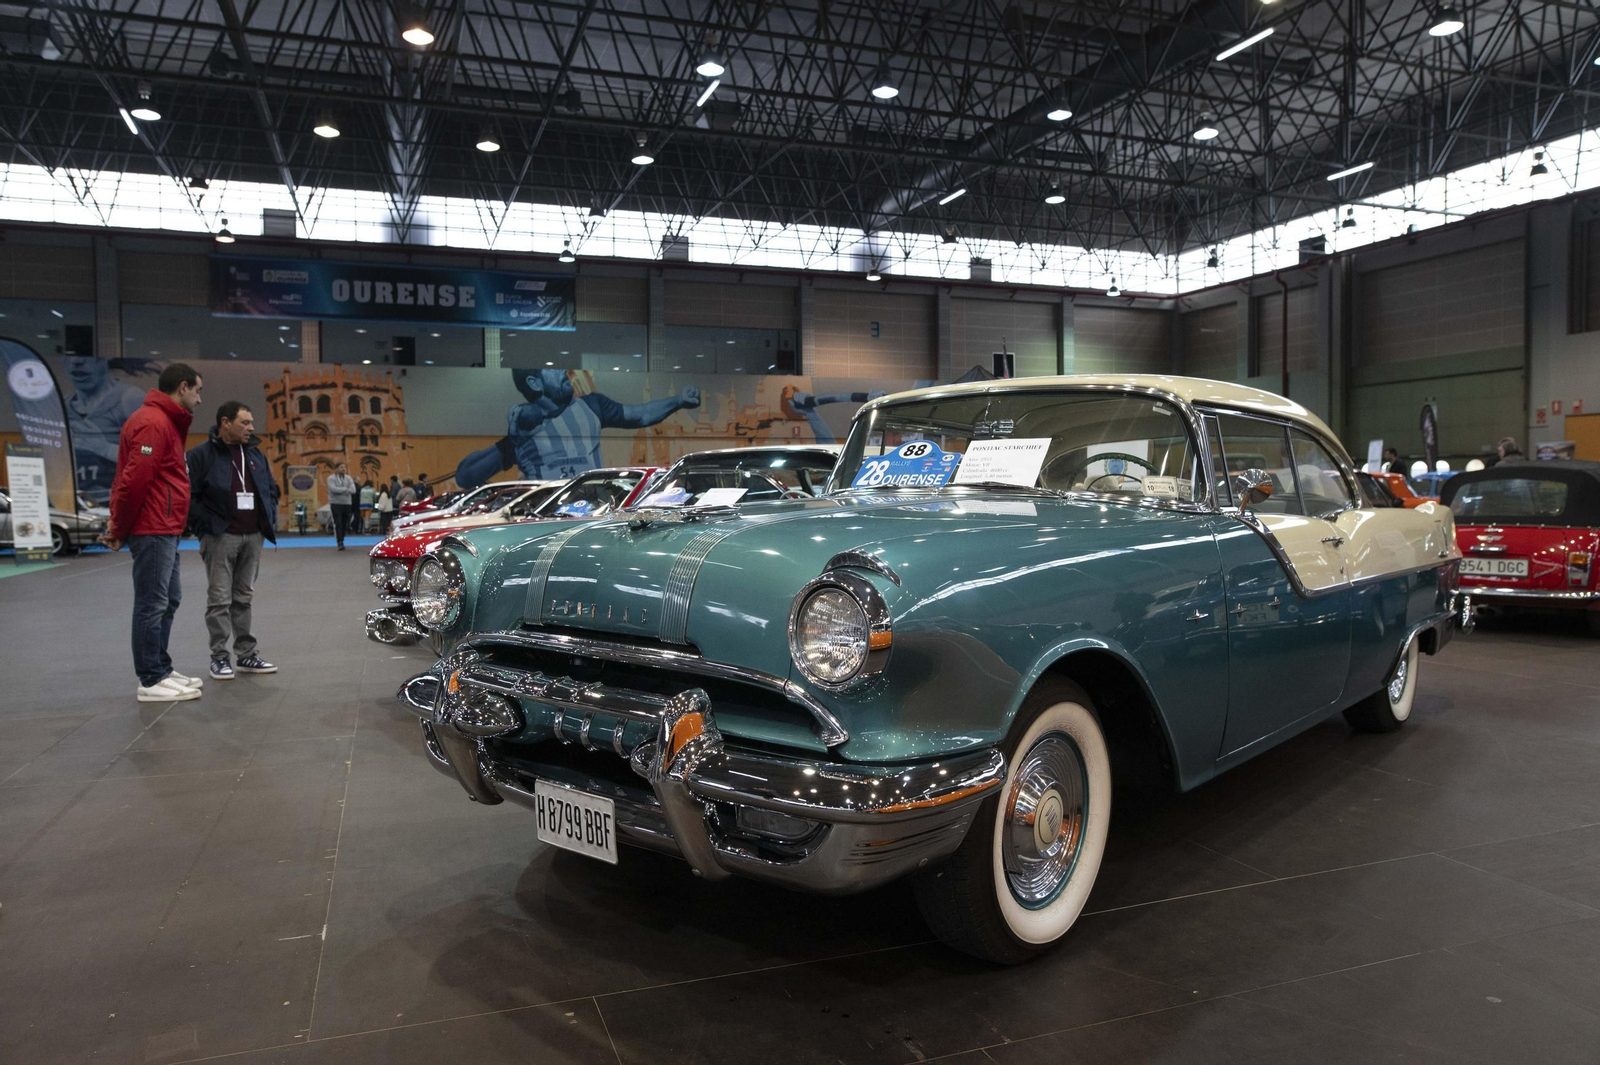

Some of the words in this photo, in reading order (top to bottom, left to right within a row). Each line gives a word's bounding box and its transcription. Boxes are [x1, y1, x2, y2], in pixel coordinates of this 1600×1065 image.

[331, 278, 476, 308] OURENSE
[903, 444, 928, 457] 88
[76, 465, 99, 480] 17
[560, 465, 576, 478] 54
[855, 460, 891, 486] 28
[882, 473, 946, 486] OURENSE
[1460, 560, 1492, 573] 9541
[1497, 562, 1524, 574] DGC
[537, 794, 546, 830] H
[548, 797, 583, 841] 8799
[585, 808, 611, 850] BBF
